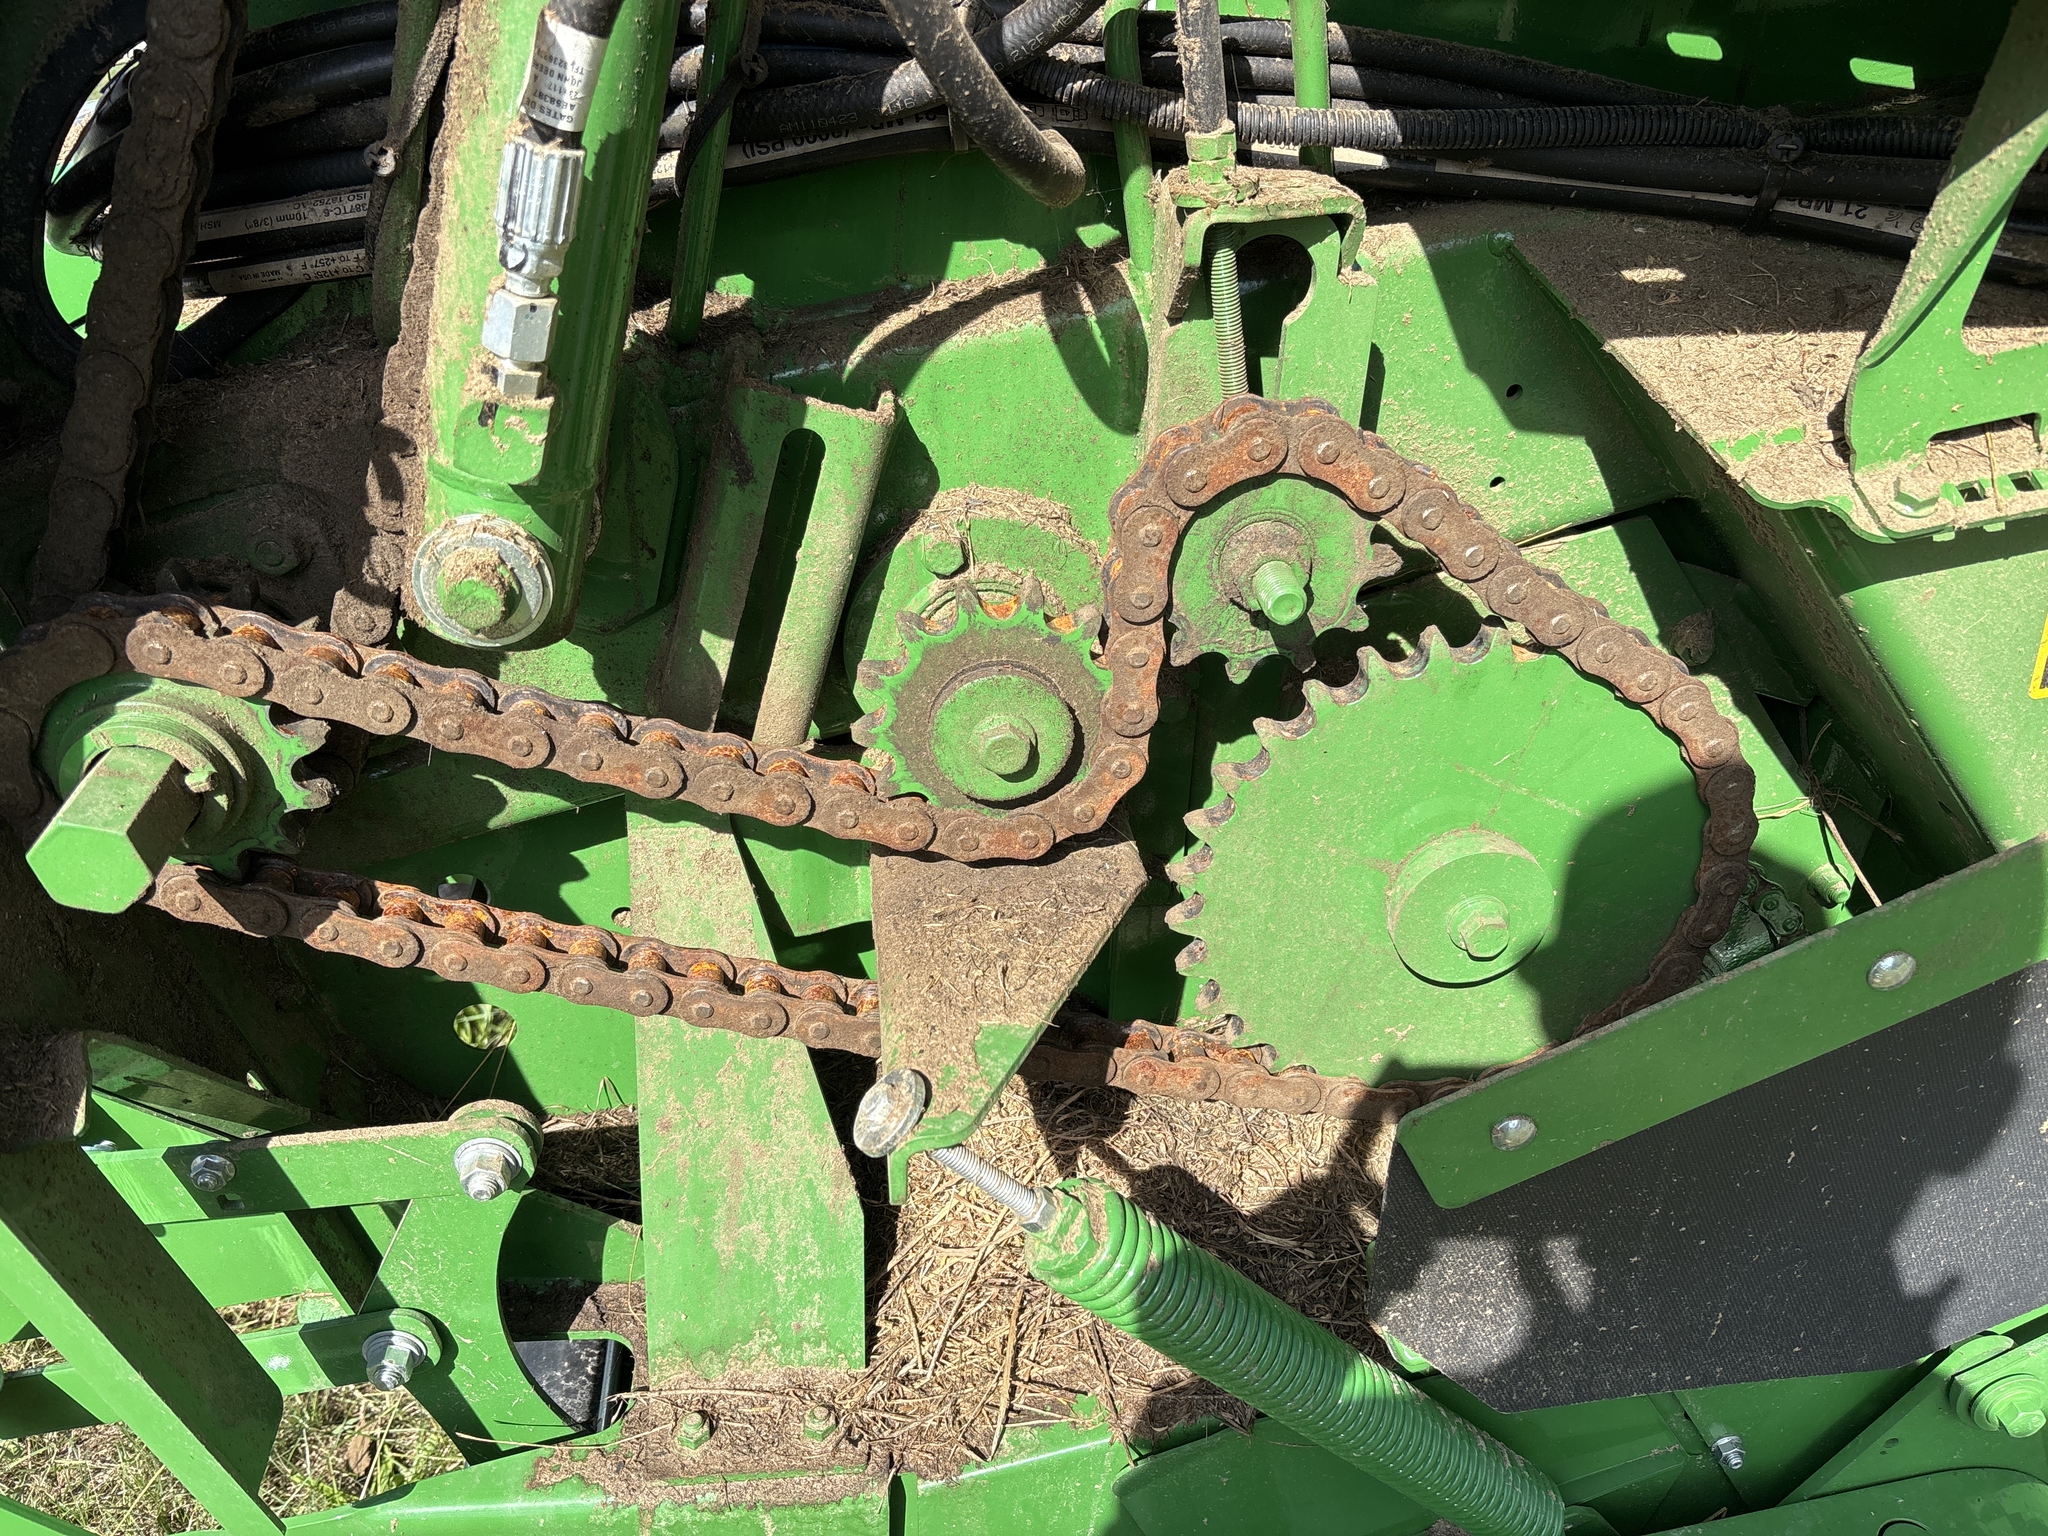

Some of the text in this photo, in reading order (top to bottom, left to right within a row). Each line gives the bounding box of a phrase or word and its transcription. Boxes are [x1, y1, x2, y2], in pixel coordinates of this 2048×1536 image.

[539, 105, 574, 123] GATES
[743, 139, 785, 159] PSI)
[347, 192, 367, 201] ISO
[323, 202, 368, 217] 387TC-6
[1843, 201, 1870, 220] 21
[275, 211, 308, 223] 10mm
[200, 219, 222, 231] MSH
[253, 272, 260, 280] IN
[261, 270, 281, 278] MADE
